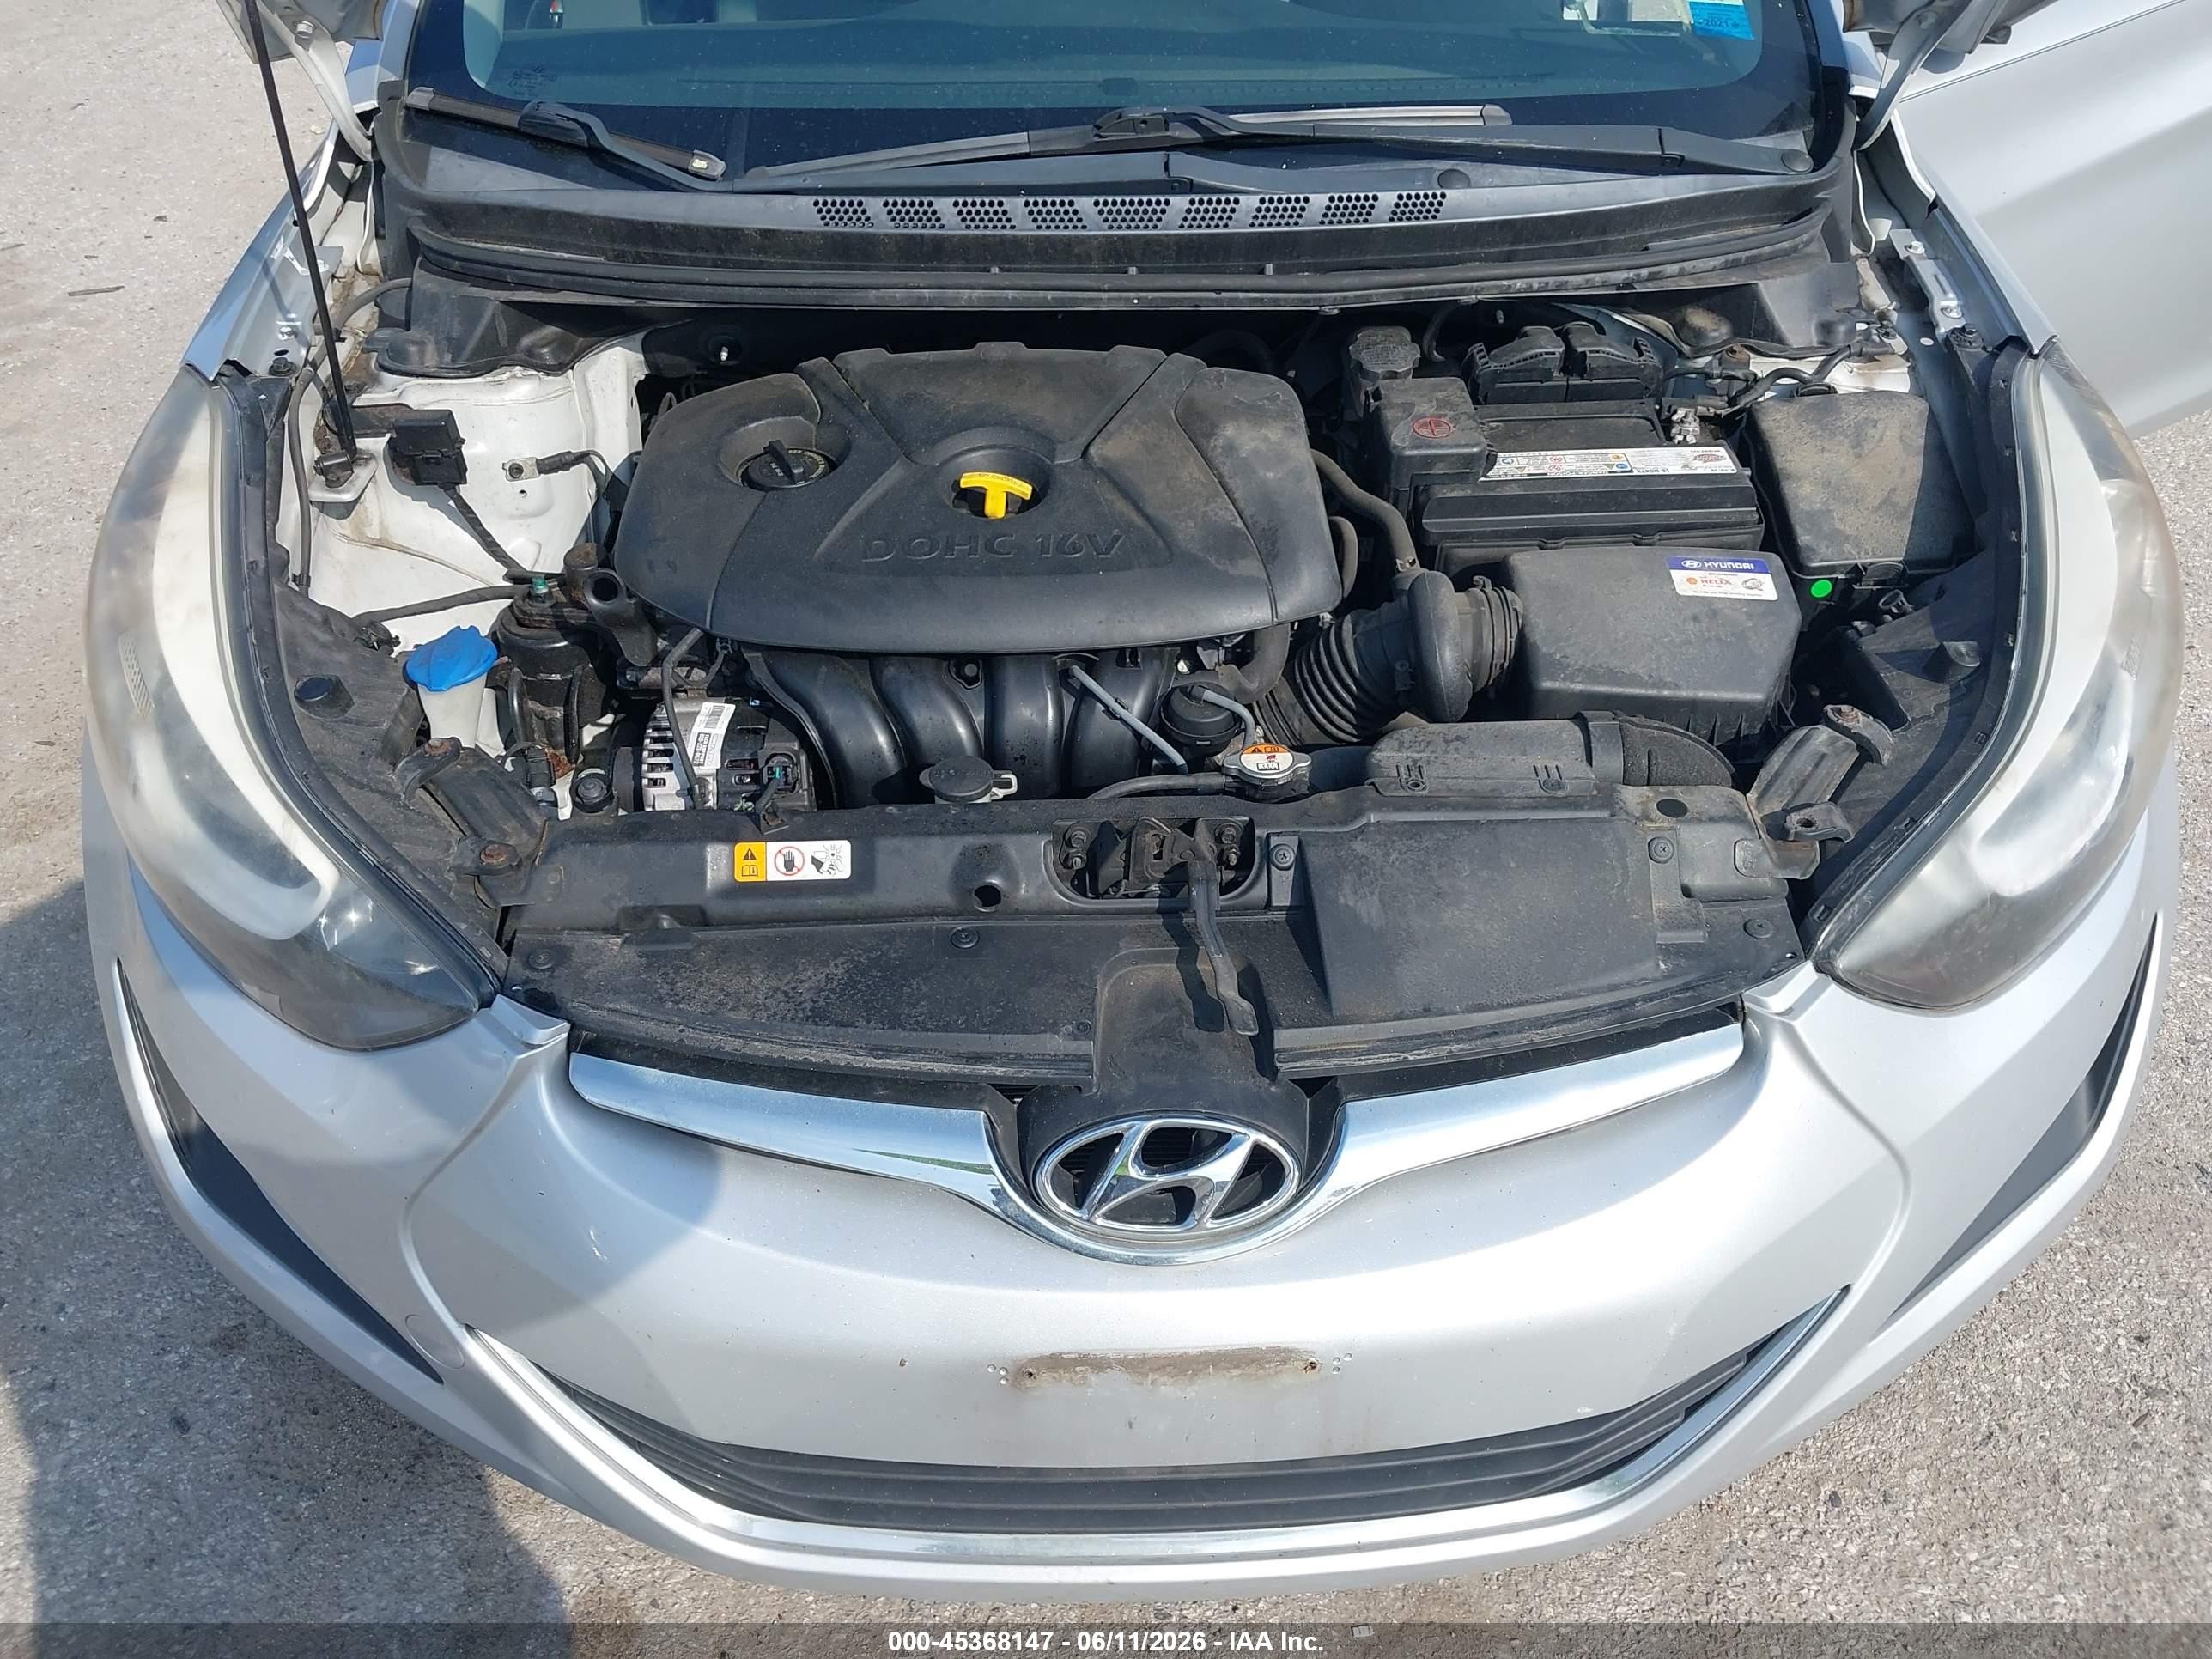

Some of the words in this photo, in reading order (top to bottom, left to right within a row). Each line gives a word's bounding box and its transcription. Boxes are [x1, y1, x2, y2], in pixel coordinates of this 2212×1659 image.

[1704, 19, 1730, 28] 2021
[860, 533, 1018, 562] DOHC
[1035, 532, 1127, 558] 16V
[1703, 561, 1755, 570] HYUNDAI
